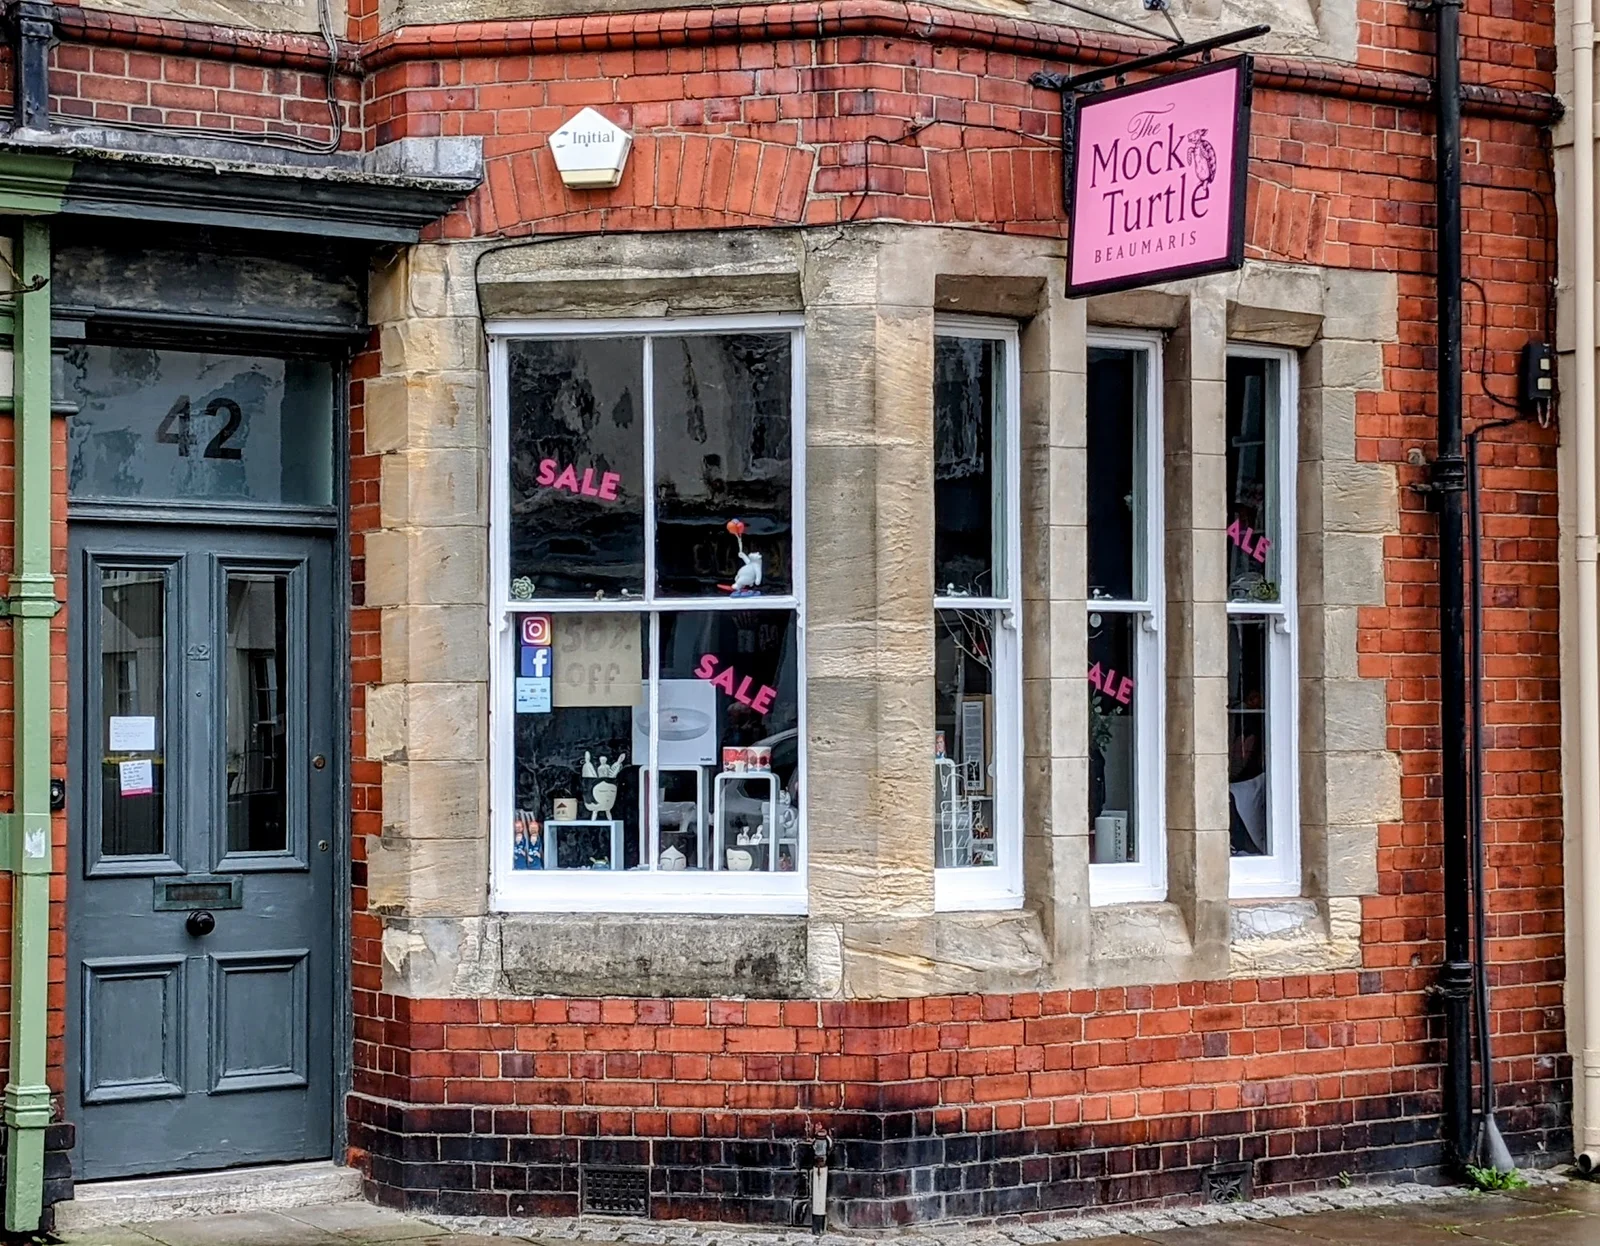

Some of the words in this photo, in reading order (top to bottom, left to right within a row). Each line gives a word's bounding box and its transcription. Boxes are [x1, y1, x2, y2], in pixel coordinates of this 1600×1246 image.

[573, 130, 615, 144] Initial
[1127, 102, 1176, 141] The
[1089, 123, 1186, 189] Mock
[1102, 172, 1210, 236] Turtle
[1094, 230, 1197, 264] BEAUMARIS
[156, 394, 242, 460] 42
[536, 458, 620, 500] SALE
[1227, 518, 1271, 563] ALE
[186, 643, 210, 661] 42
[694, 654, 777, 715] SALE
[1088, 661, 1134, 705] ALE
